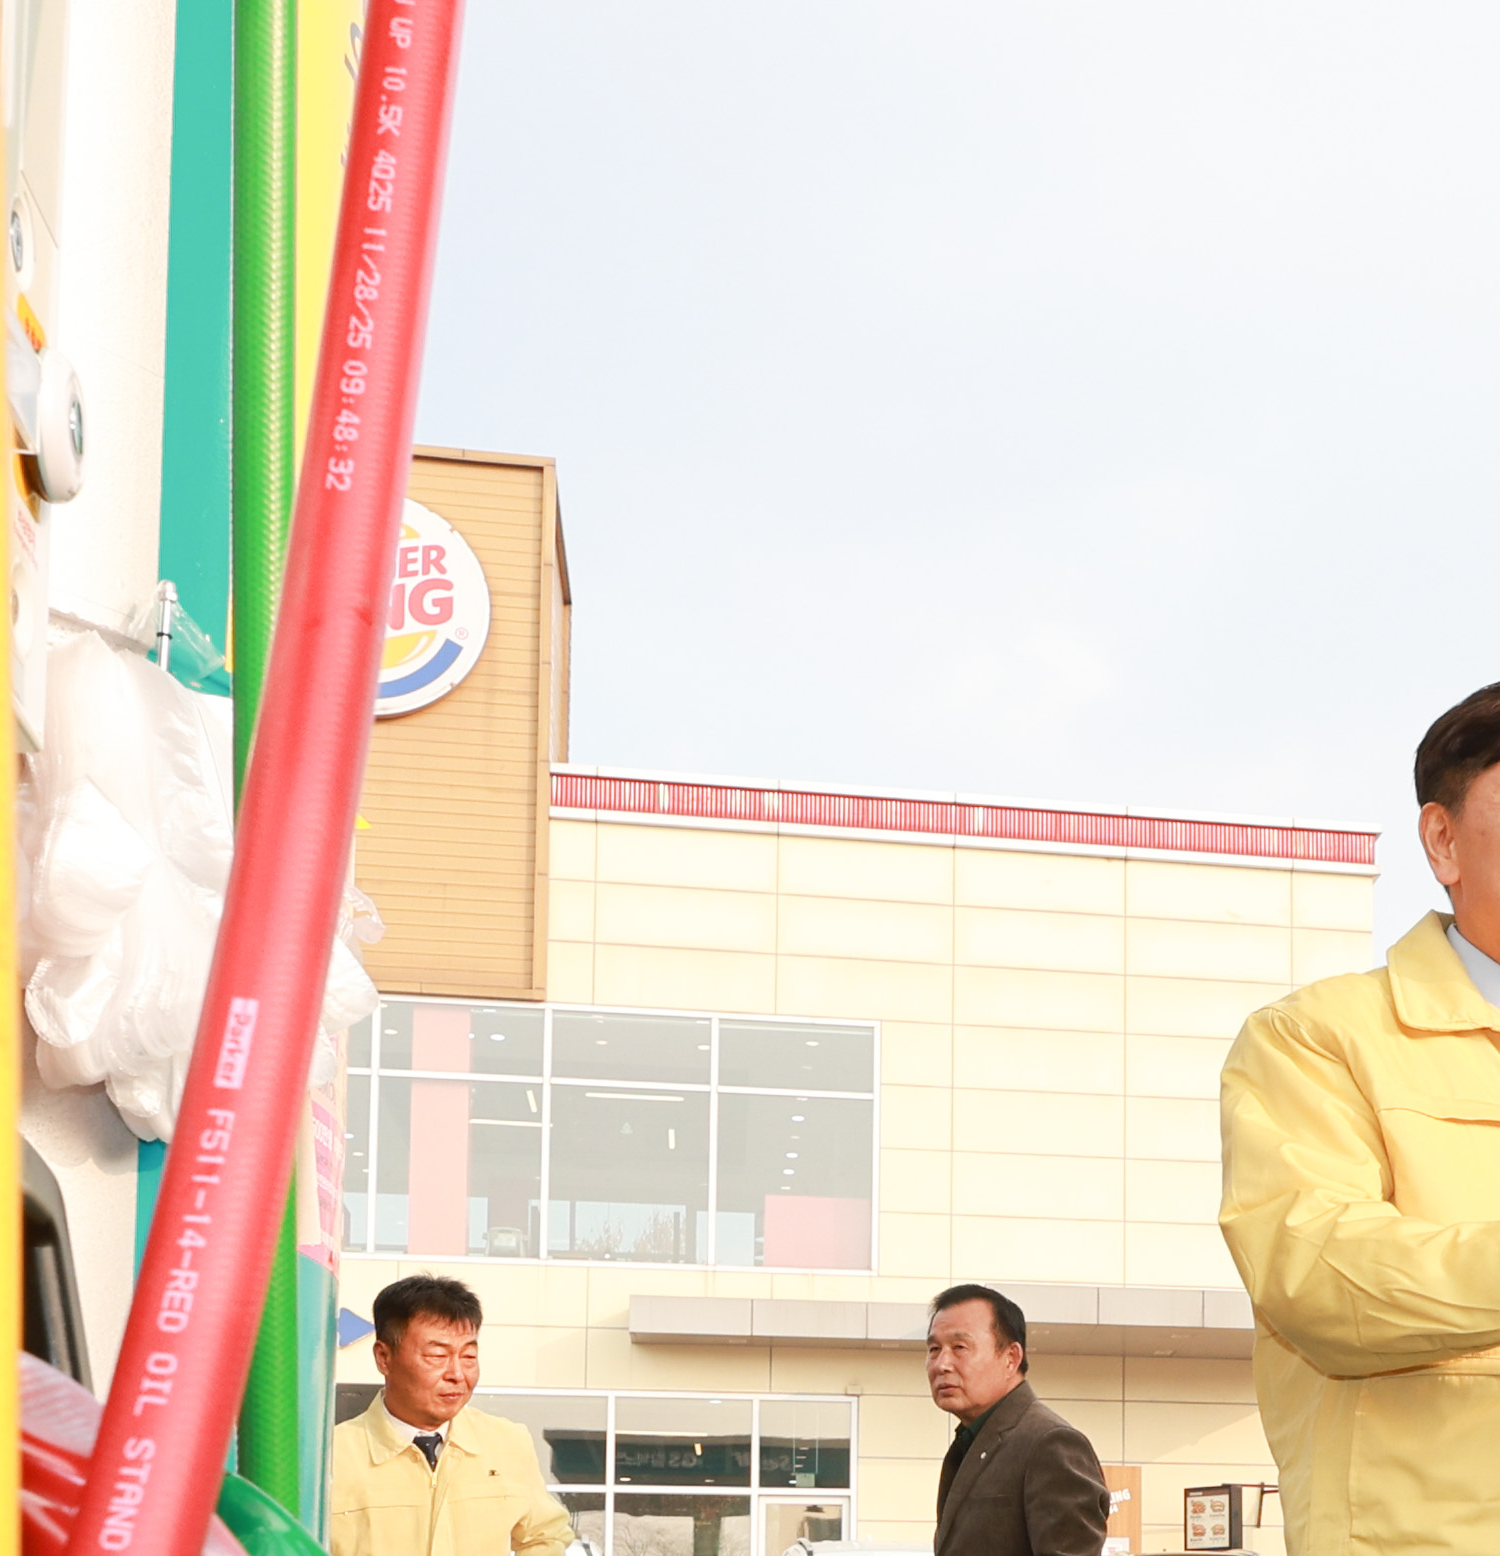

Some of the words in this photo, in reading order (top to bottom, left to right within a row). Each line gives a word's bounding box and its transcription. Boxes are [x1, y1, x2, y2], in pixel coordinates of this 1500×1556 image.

[346, 227, 387, 350] 11/28/25
[325, 359, 368, 491] 09:48:32
[132, 1351, 178, 1418] OIL
[98, 1436, 157, 1552] STAND
